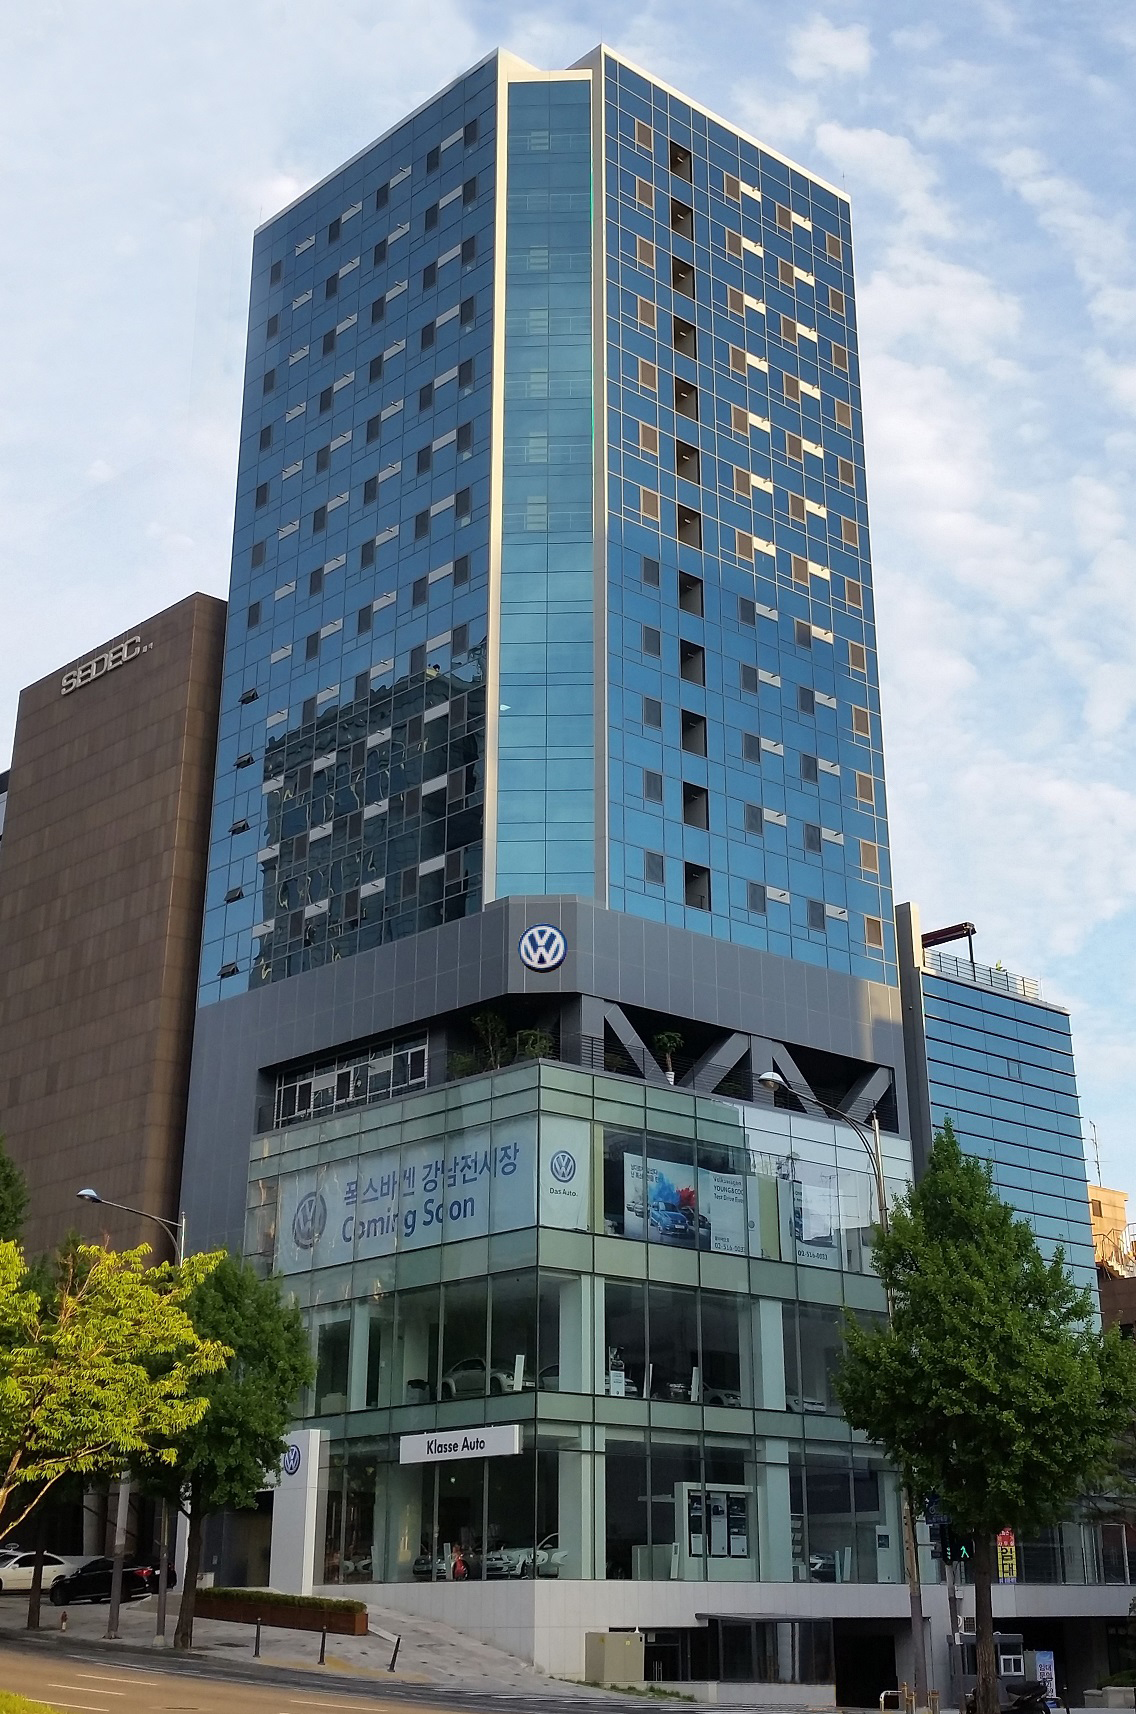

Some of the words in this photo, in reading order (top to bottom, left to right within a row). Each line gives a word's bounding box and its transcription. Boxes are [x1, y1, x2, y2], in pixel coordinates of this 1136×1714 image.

[61, 636, 141, 695] SEDEC
[550, 1187, 562, 1195] Das
[342, 1207, 417, 1243] Coming
[422, 1197, 475, 1227] Soon
[426, 1439, 459, 1455] Klasse
[461, 1436, 486, 1452] Auto
